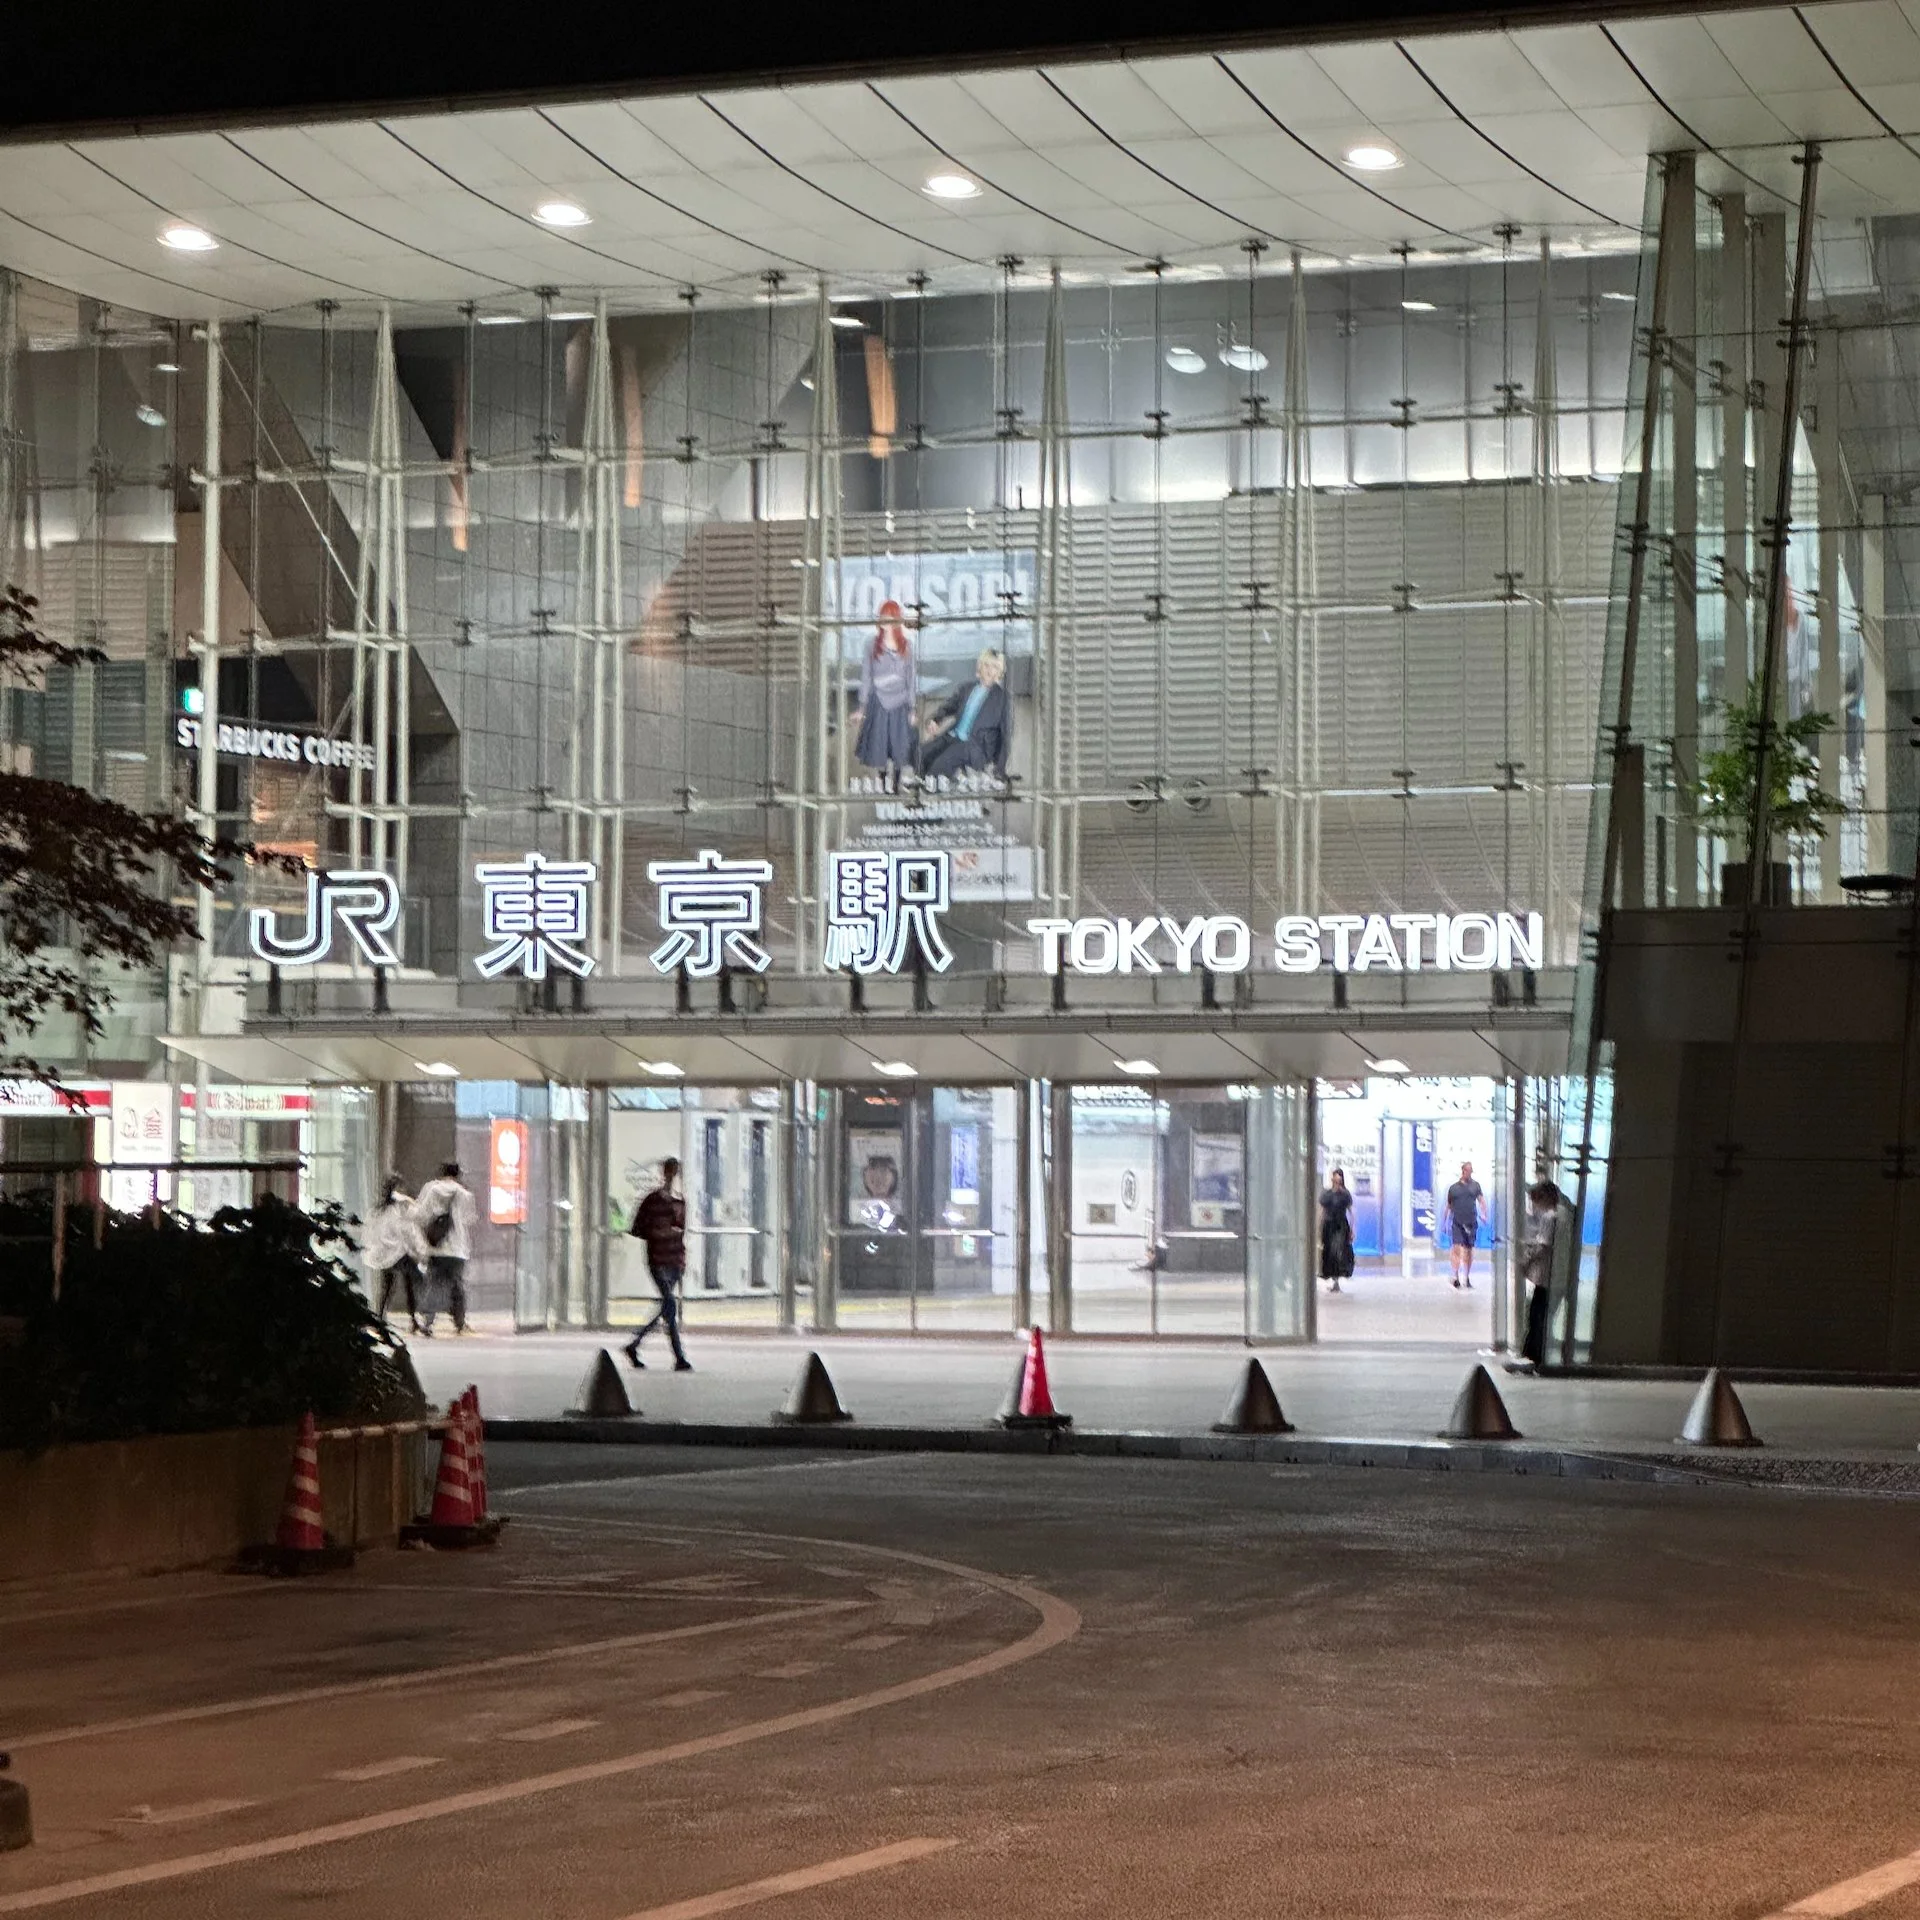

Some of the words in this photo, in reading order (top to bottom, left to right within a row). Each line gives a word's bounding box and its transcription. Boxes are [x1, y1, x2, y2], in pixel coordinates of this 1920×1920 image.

[177, 718, 301, 761] STRBUCKS
[250, 871, 400, 965] JR
[474, 851, 954, 977] 東京駅
[1028, 916, 1250, 974] TOKYO
[1276, 913, 1544, 973] STATION
